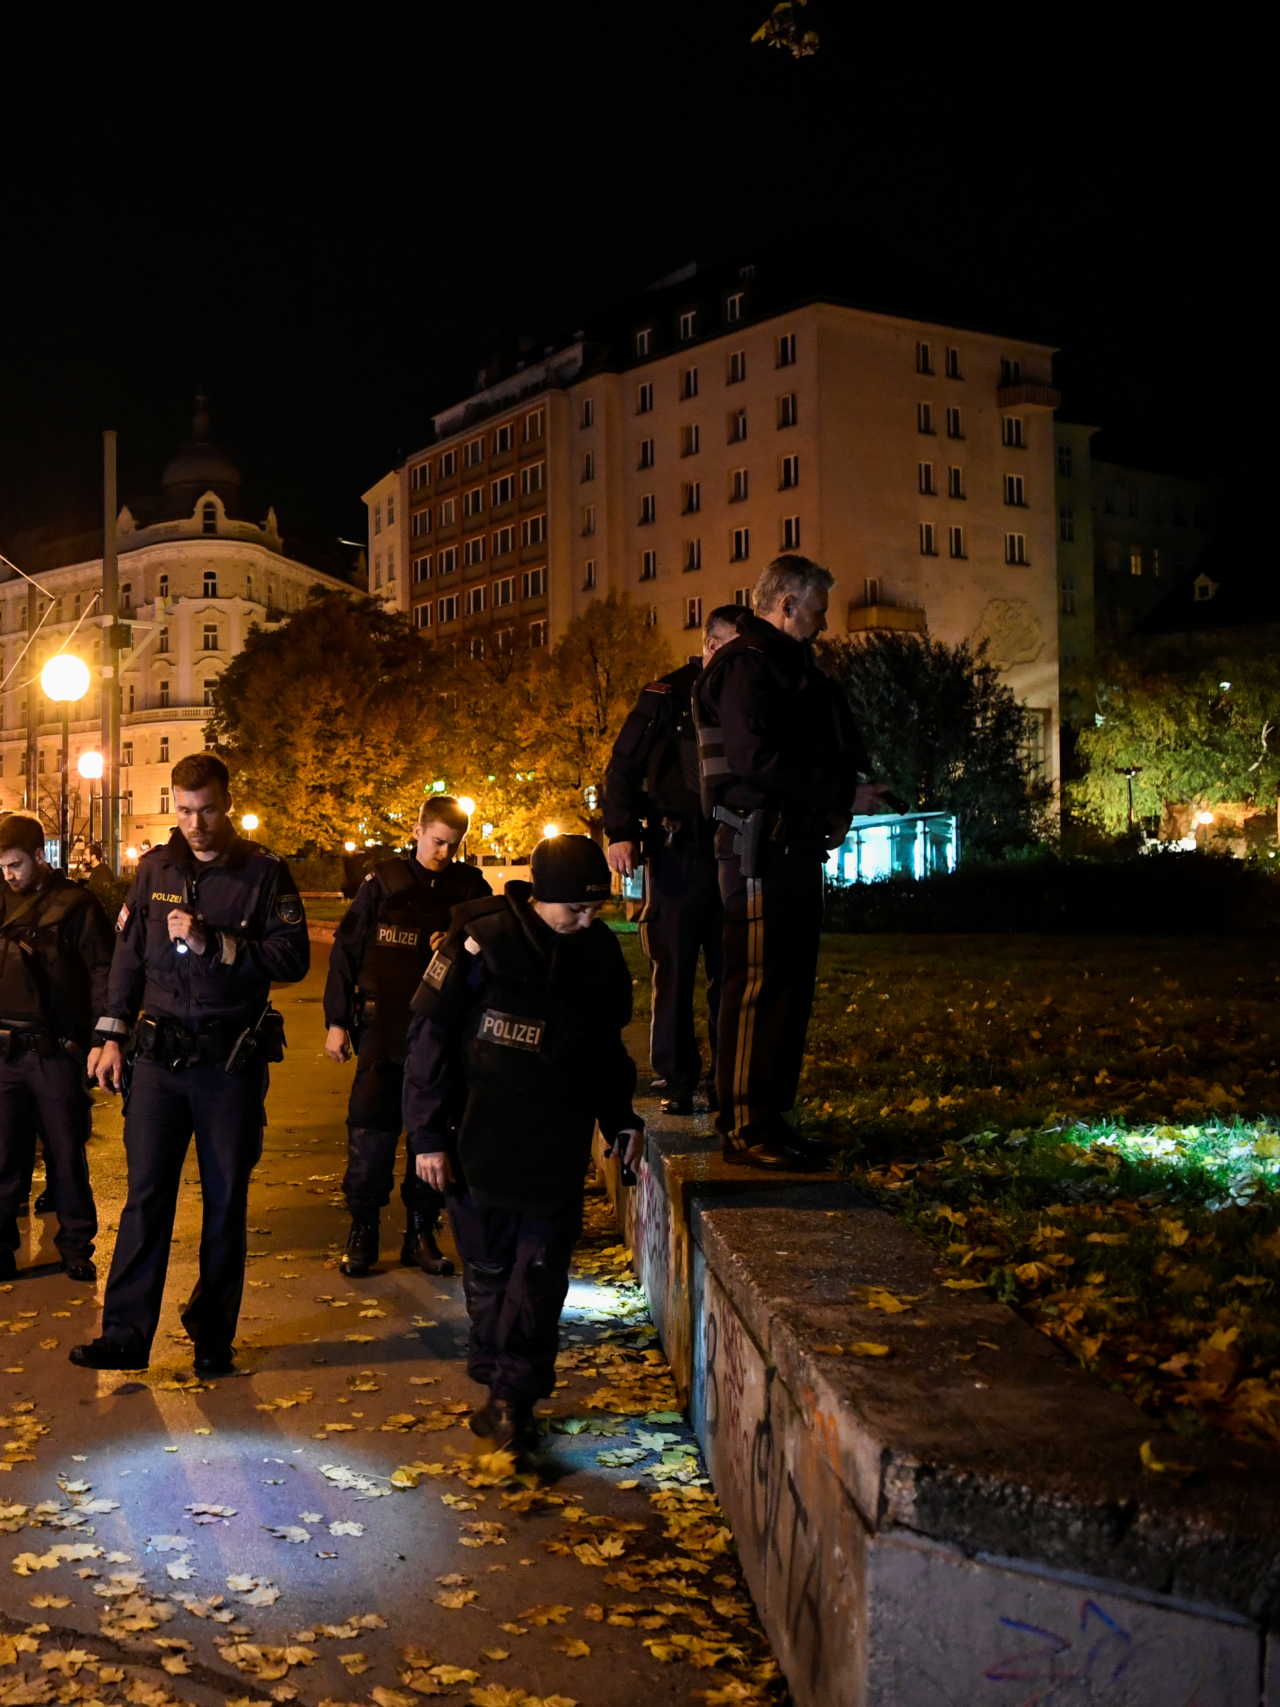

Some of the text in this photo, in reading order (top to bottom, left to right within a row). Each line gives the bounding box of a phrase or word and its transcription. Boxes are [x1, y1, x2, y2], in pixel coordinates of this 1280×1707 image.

[151, 892, 183, 904] POLIZEI
[378, 928, 418, 947] POLIZEI
[483, 1016, 542, 1046] POLIZEI
